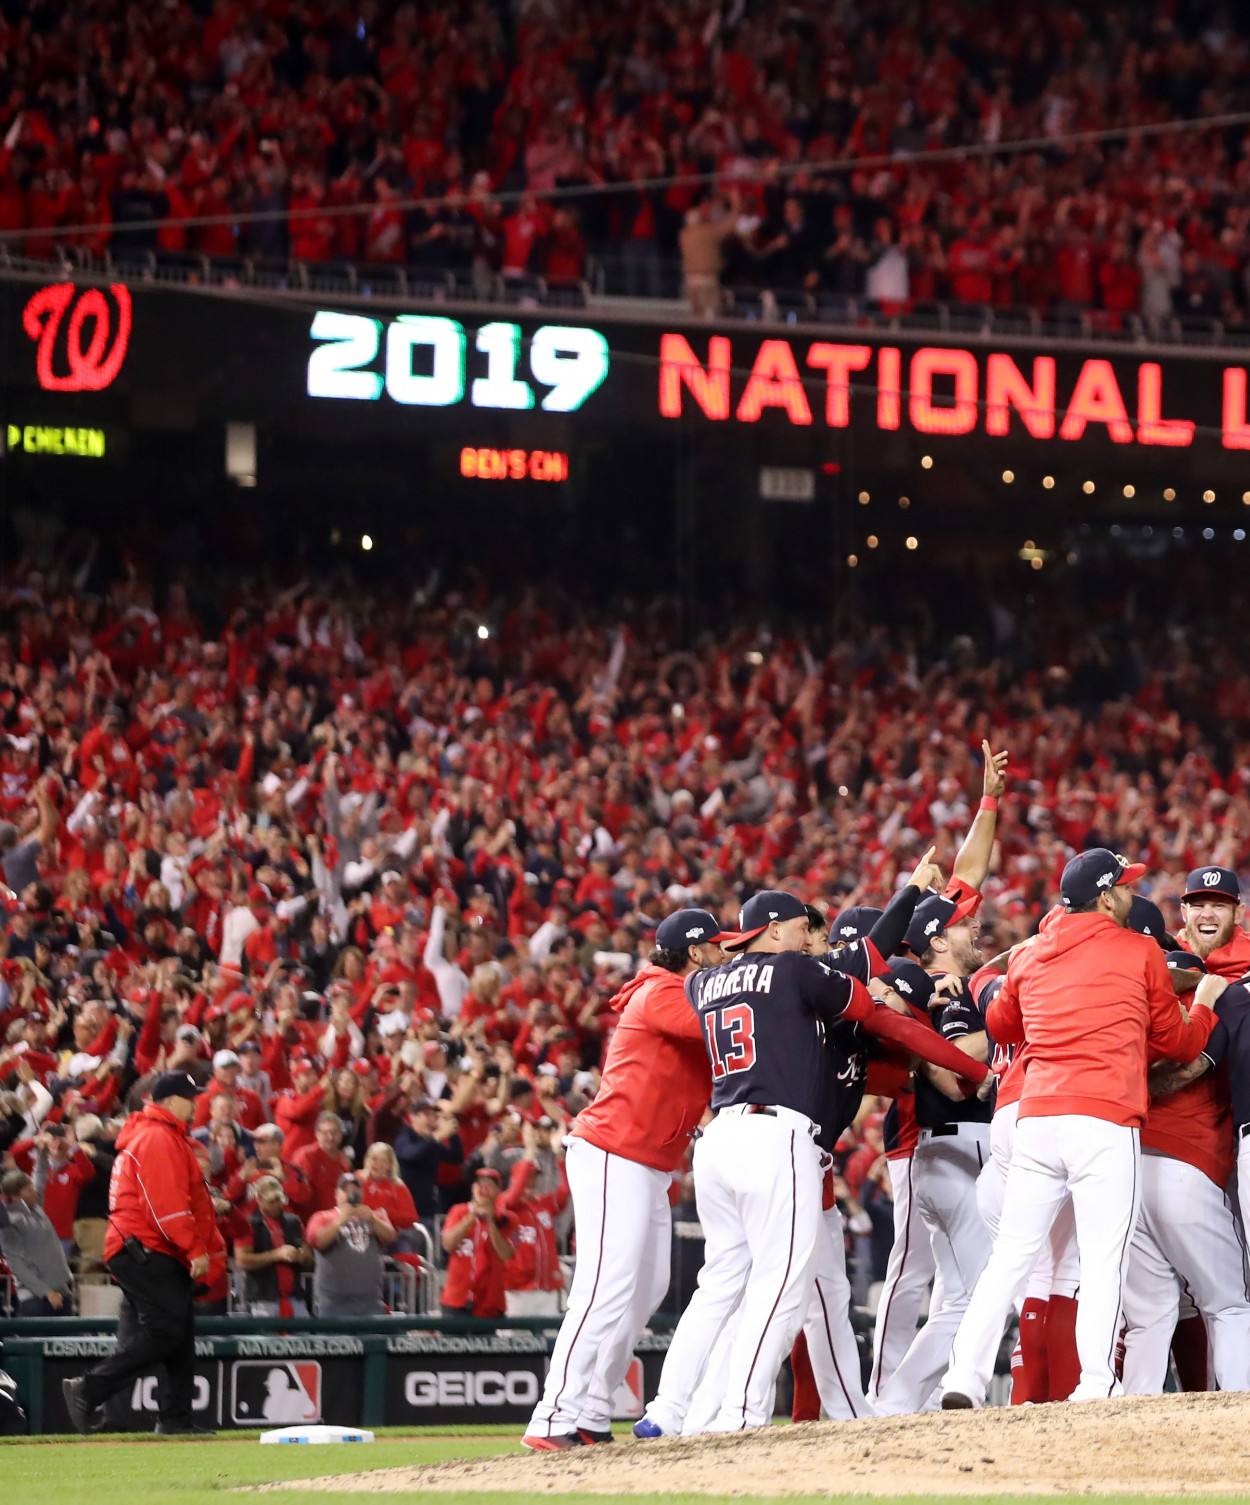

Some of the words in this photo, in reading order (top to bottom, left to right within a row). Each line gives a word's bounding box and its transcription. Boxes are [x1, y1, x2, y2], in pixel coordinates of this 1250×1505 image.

[307, 311, 609, 412] 2019
[659, 333, 1196, 447] NATIONAL
[1202, 871, 1221, 887] W
[698, 963, 774, 1010] CABRERA
[705, 1002, 757, 1080] 13
[237, 1338, 364, 1357] NATIONALS.COM
[405, 1370, 539, 1407] GEICO
